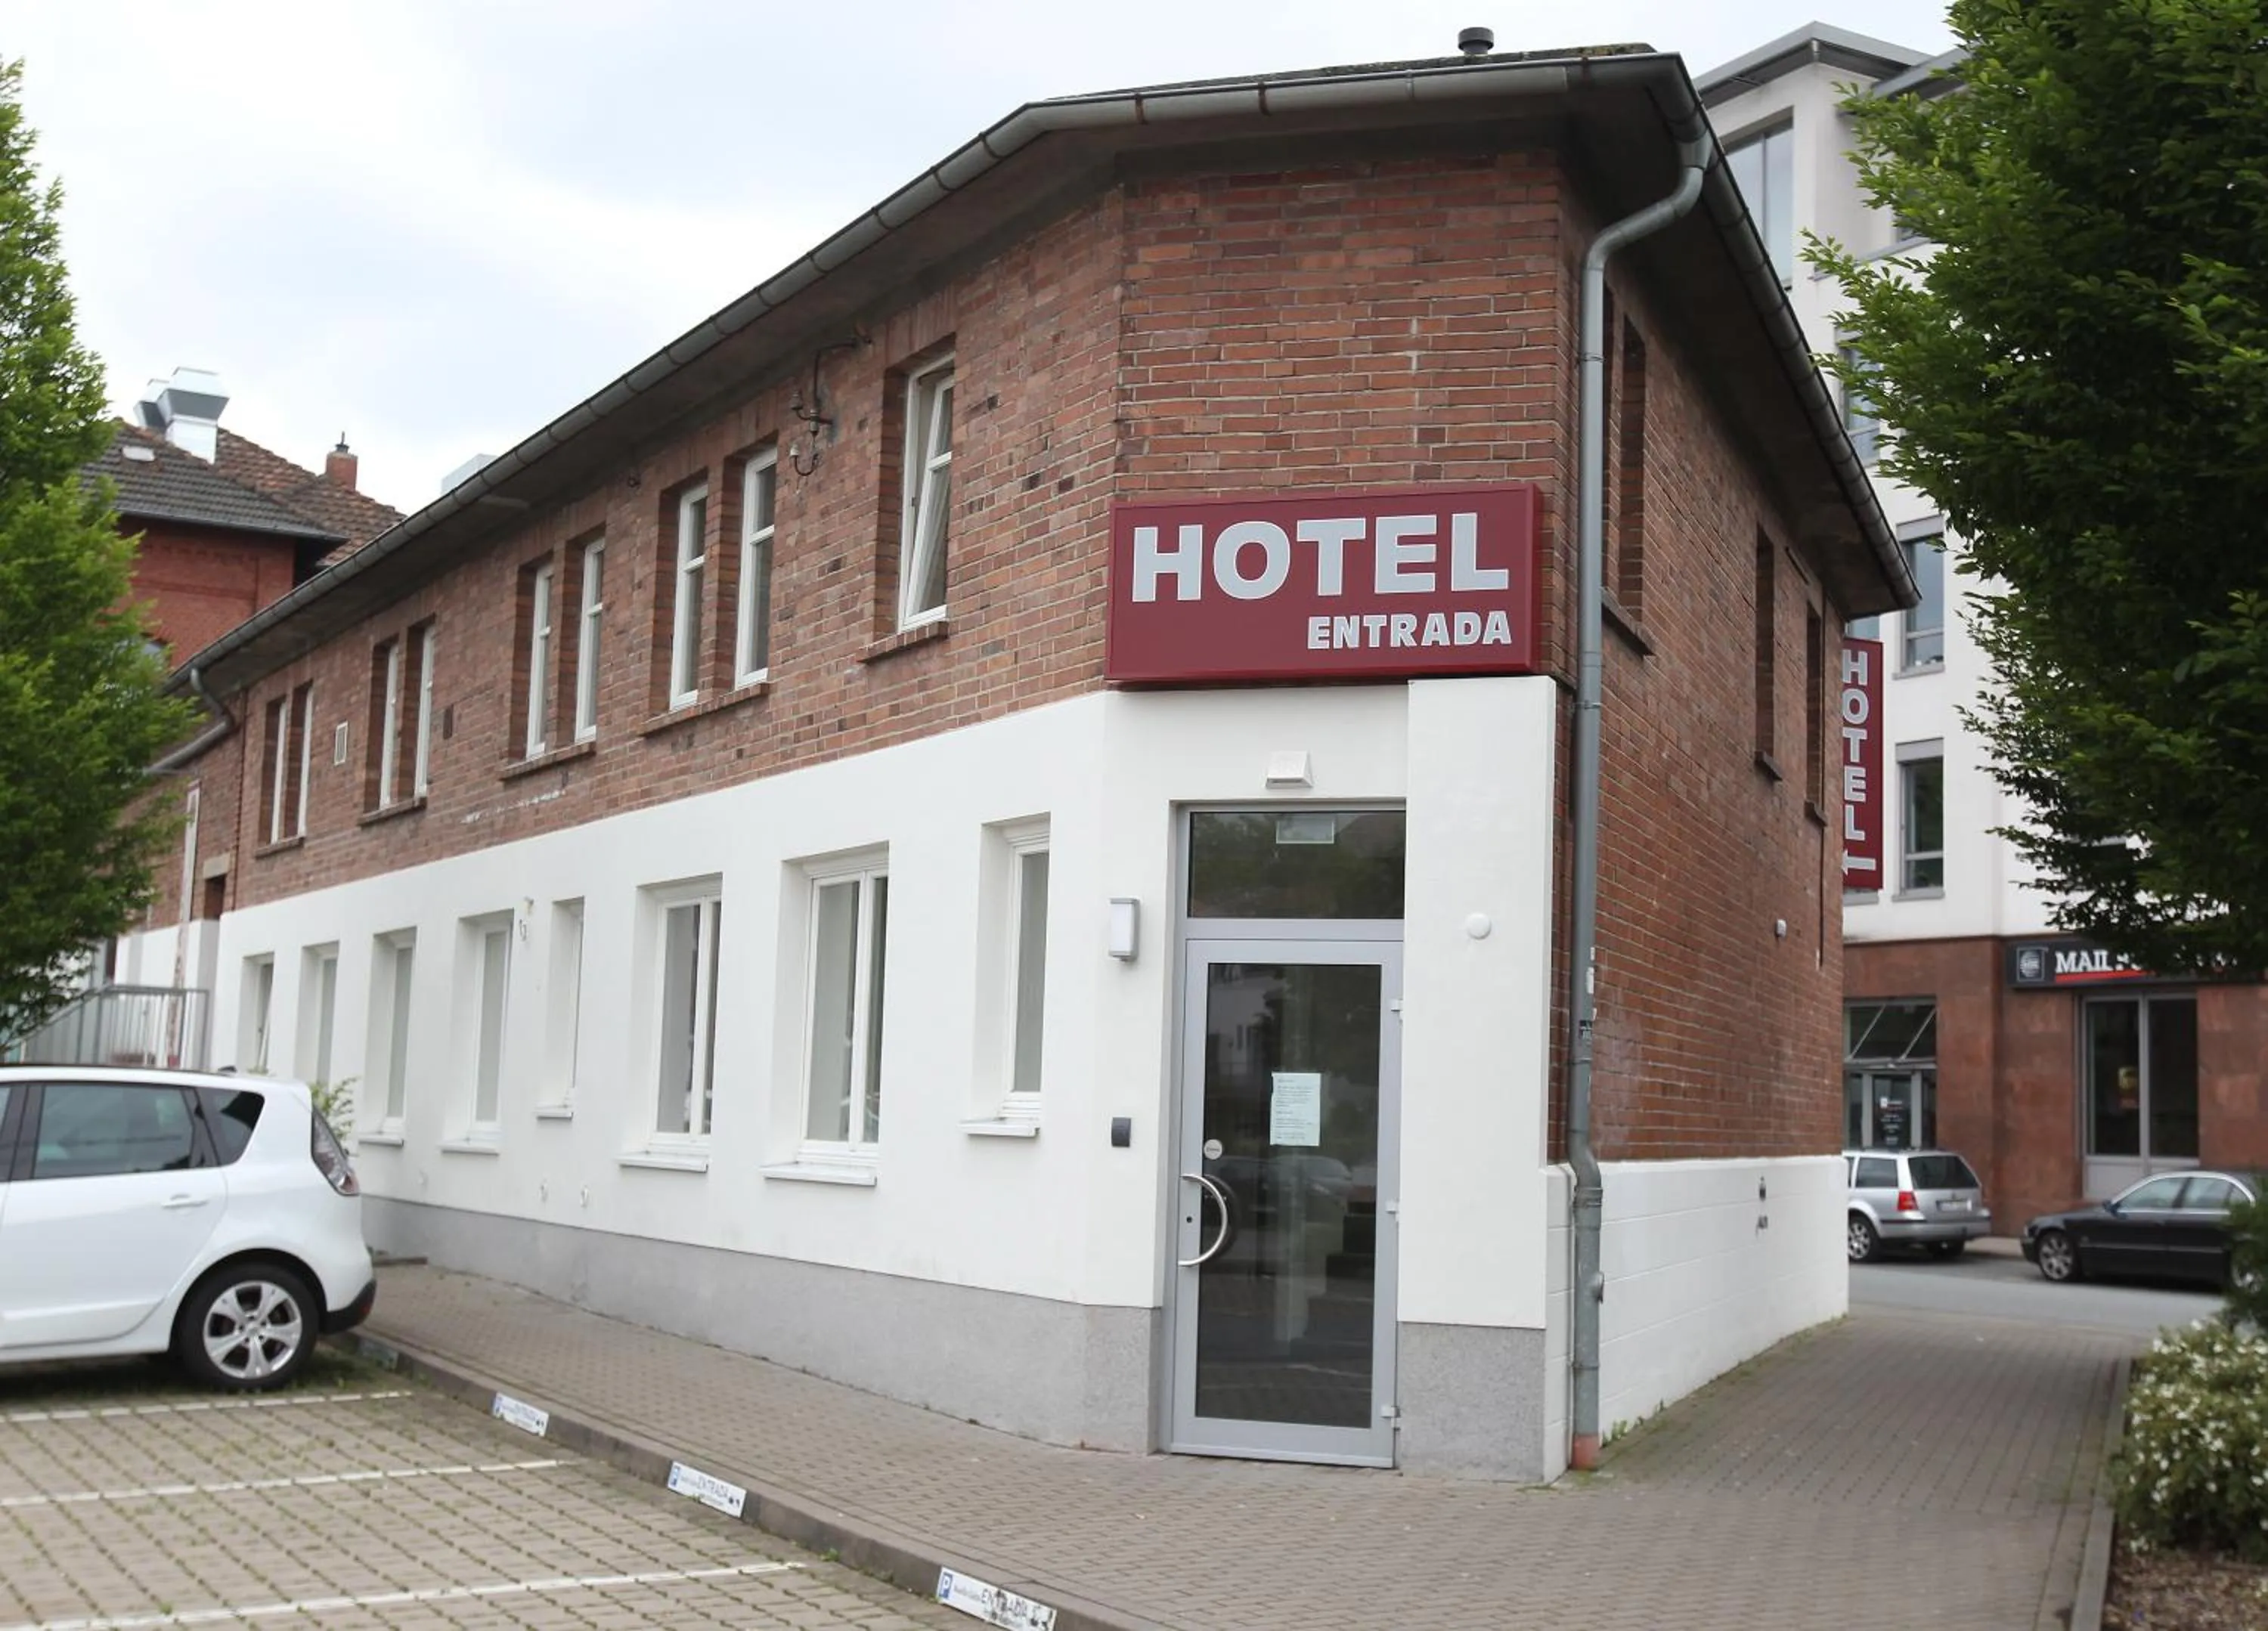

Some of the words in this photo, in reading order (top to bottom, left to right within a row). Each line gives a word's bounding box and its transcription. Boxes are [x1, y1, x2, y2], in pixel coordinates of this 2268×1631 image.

[1132, 512, 1509, 602] HOTEL
[1307, 611, 1512, 649] ENTRADA
[1842, 649, 1869, 841] HOTEL
[2055, 949, 2114, 973] MAIL
